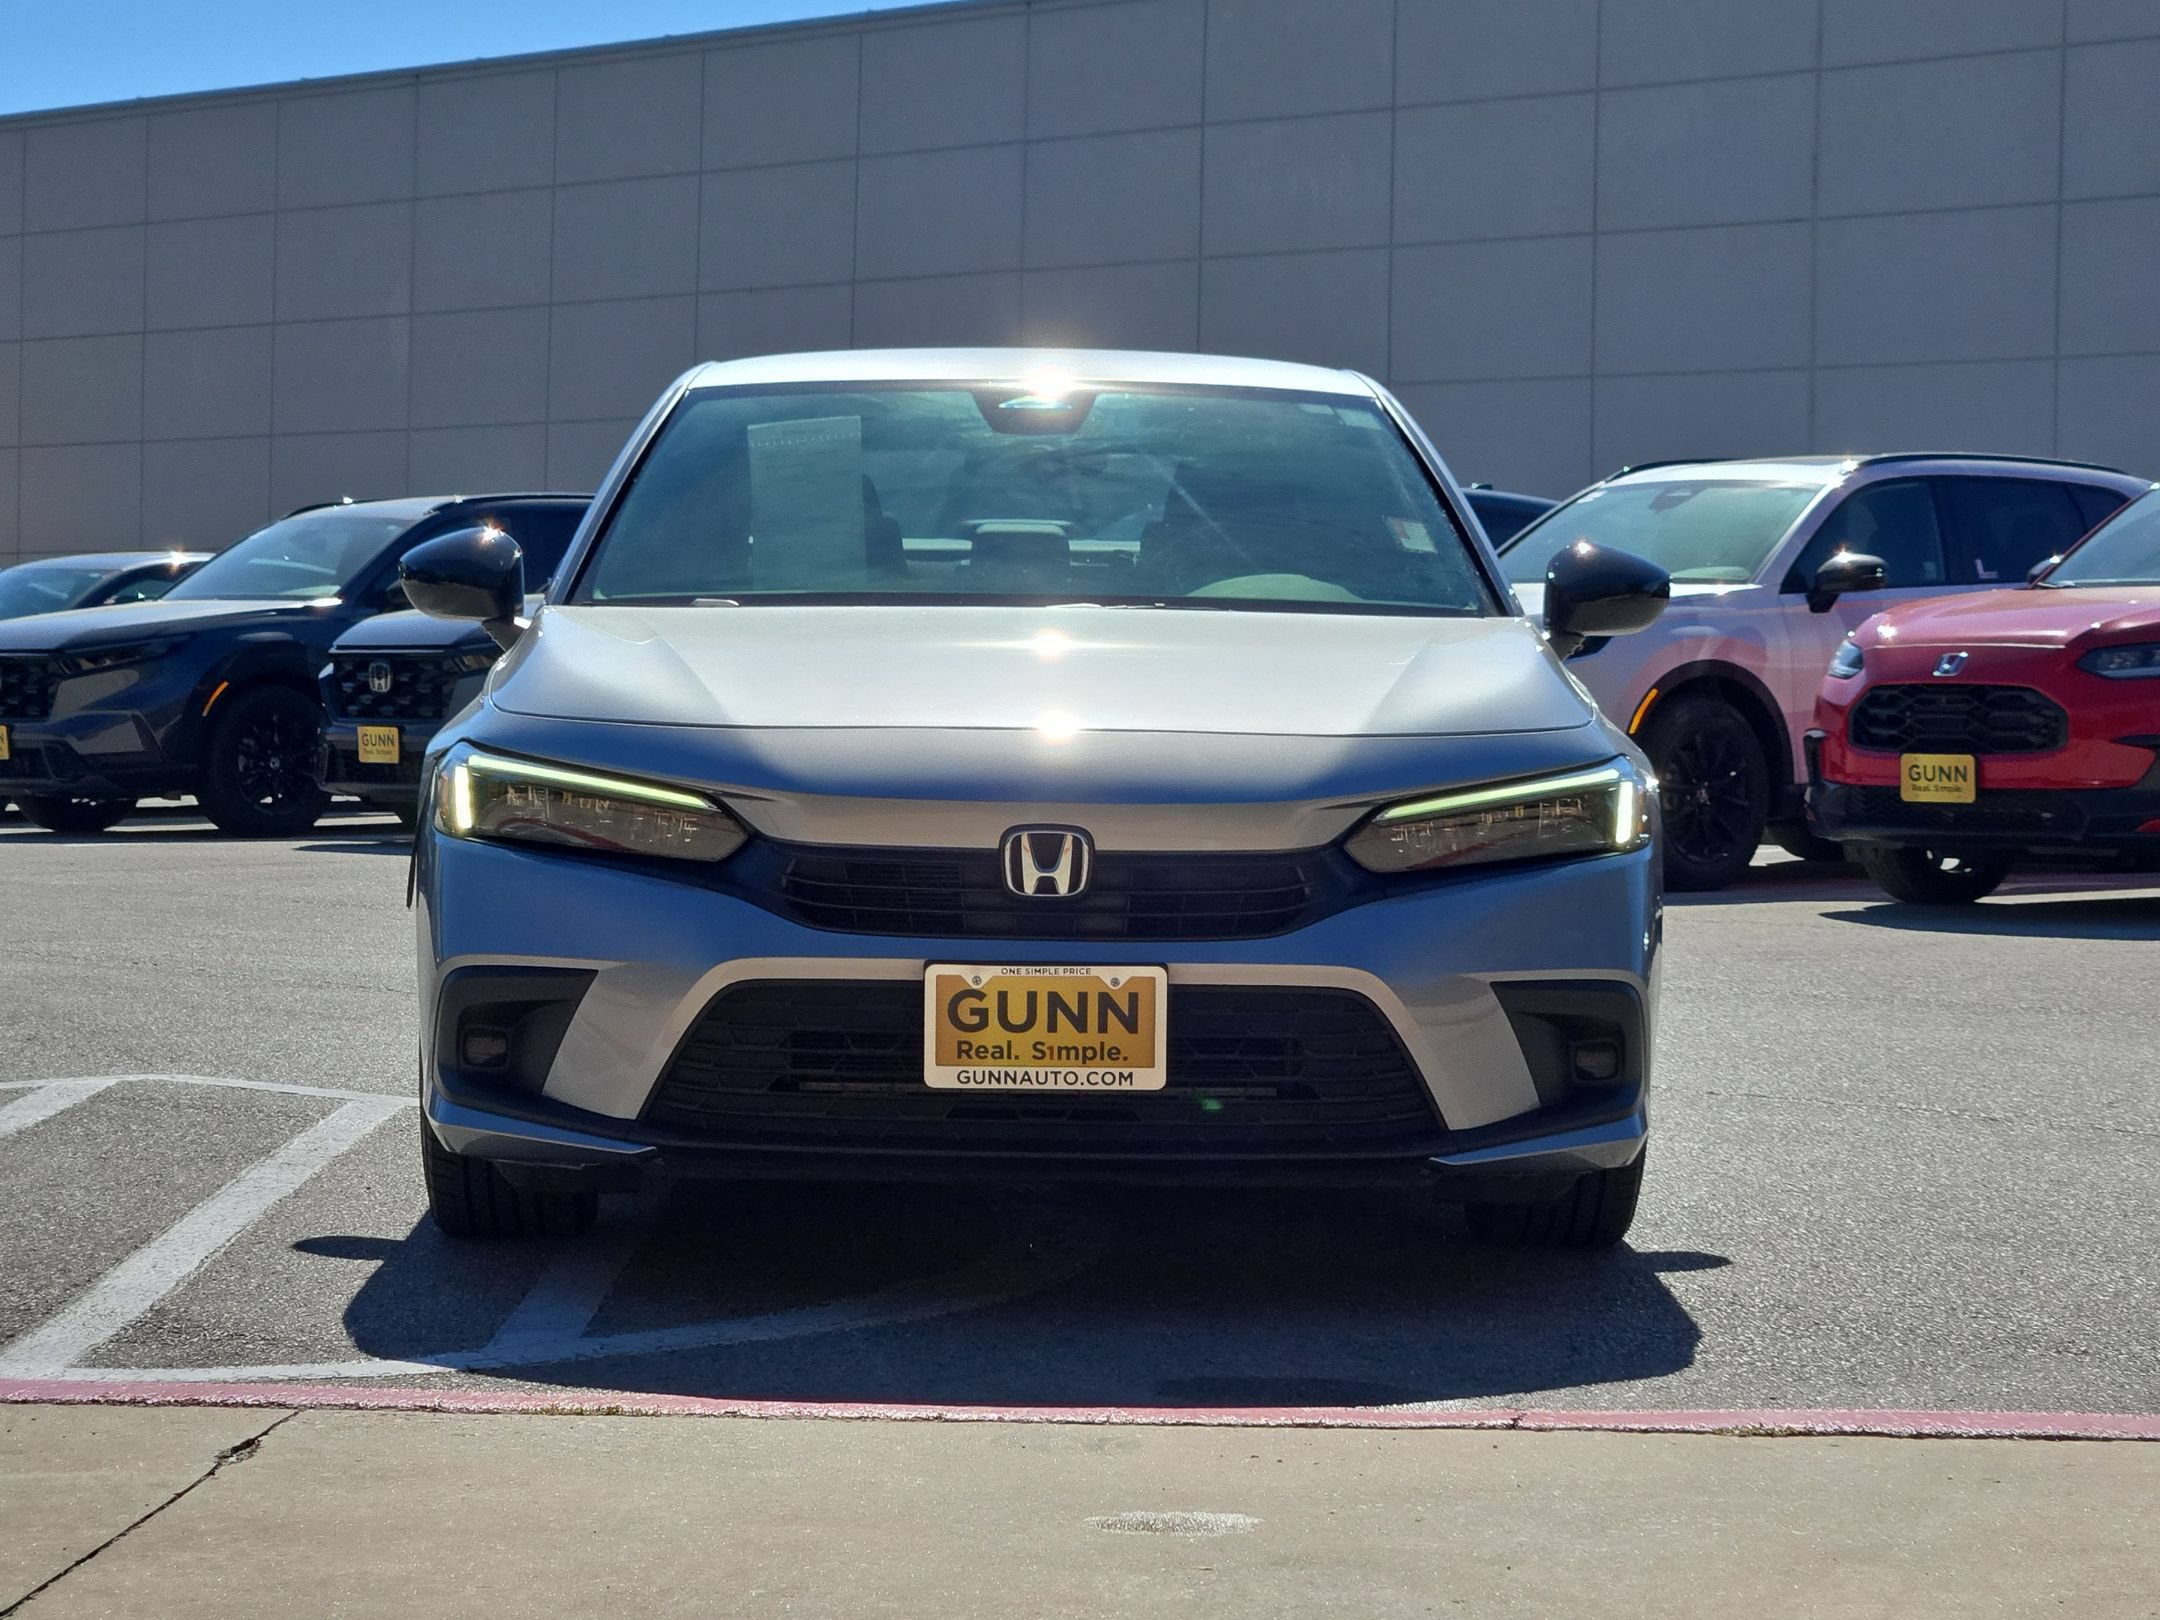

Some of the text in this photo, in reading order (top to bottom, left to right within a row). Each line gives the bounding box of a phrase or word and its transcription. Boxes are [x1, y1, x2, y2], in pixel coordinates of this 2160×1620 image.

[361, 733, 395, 747] GUNN
[1908, 764, 1967, 782] GUNN
[1001, 967, 1092, 976] ONE SIMPLE PRICE
[947, 988, 1139, 1034] GUNN
[956, 1040, 1020, 1060] Real.
[956, 1069, 1134, 1086] GUNNAUTO.COM
